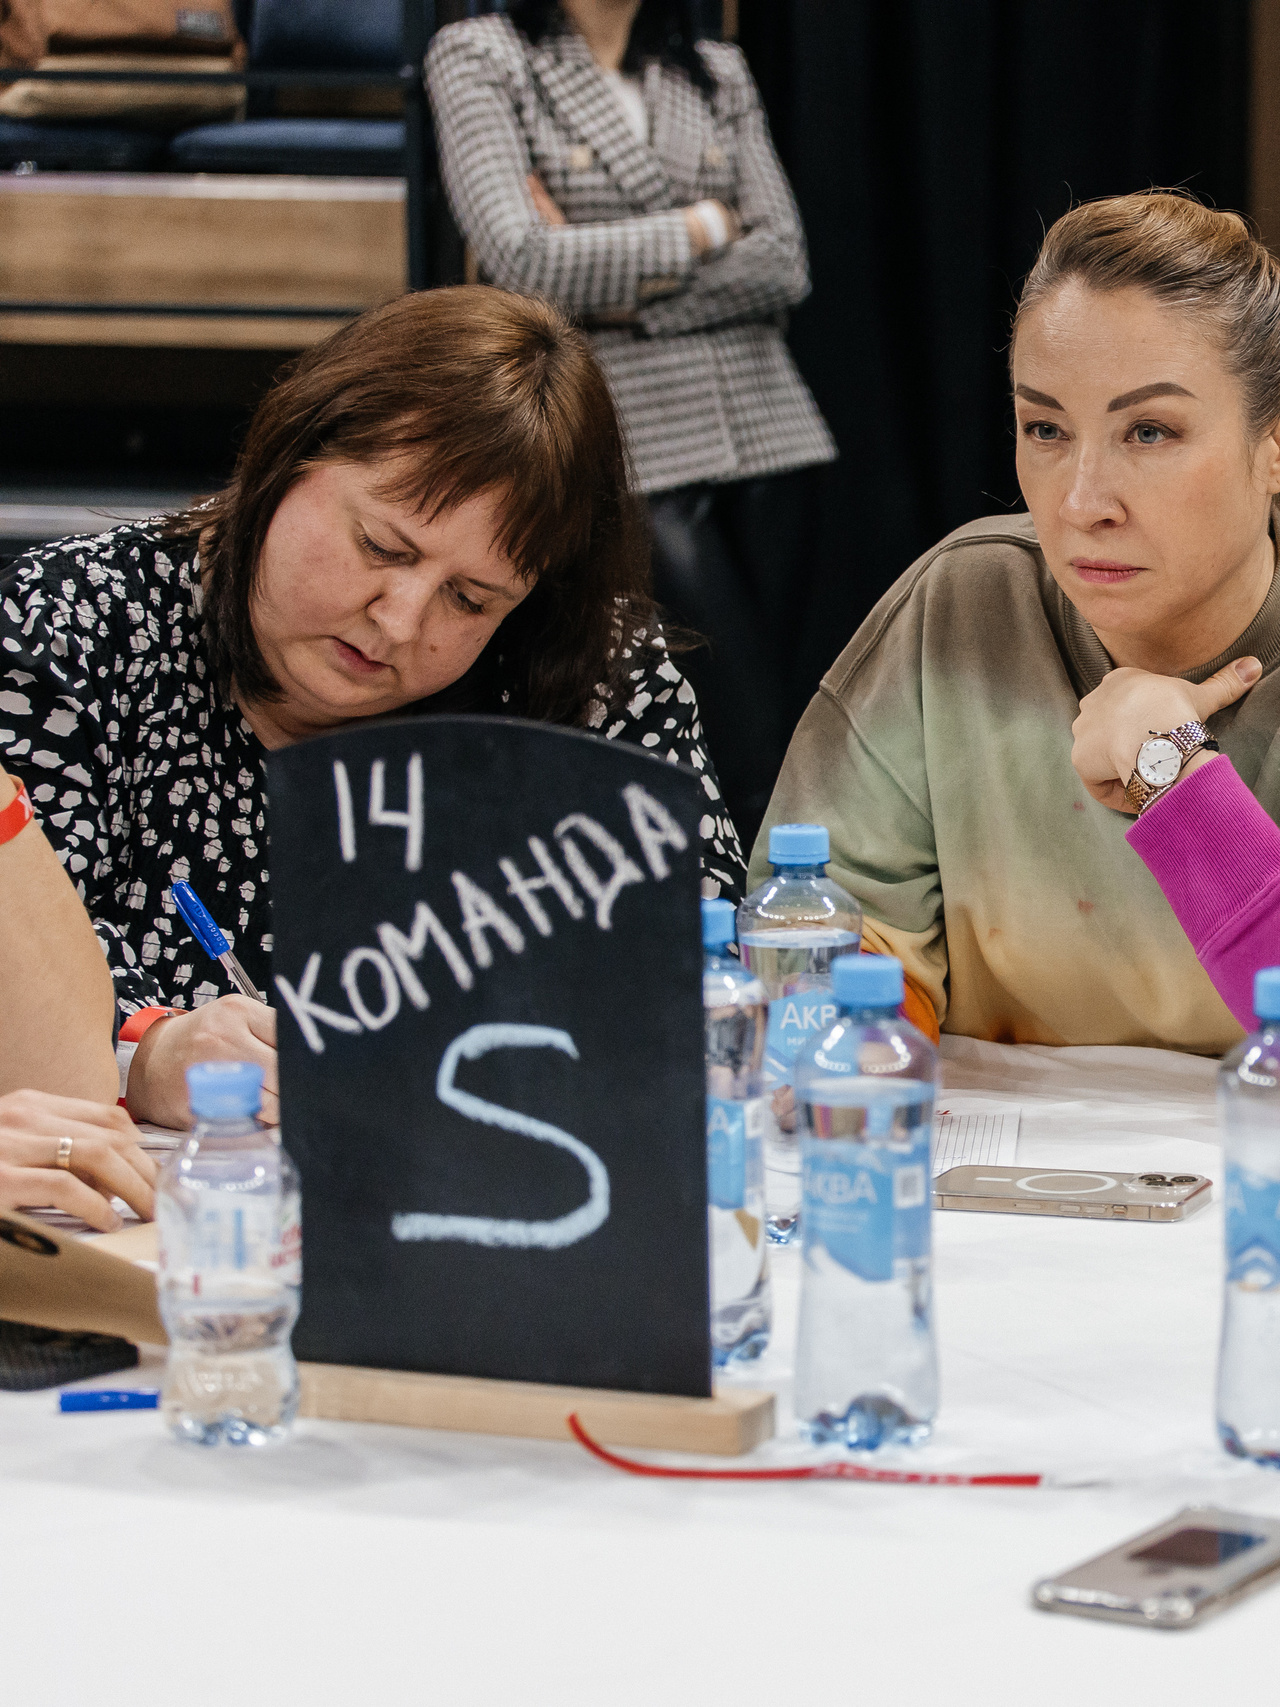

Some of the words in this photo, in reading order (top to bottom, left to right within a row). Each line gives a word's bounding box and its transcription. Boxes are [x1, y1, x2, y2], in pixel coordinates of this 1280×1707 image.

[275, 782, 689, 1054] КОМАНДА
[333, 752, 425, 872] 14
[391, 1022, 611, 1249] S
